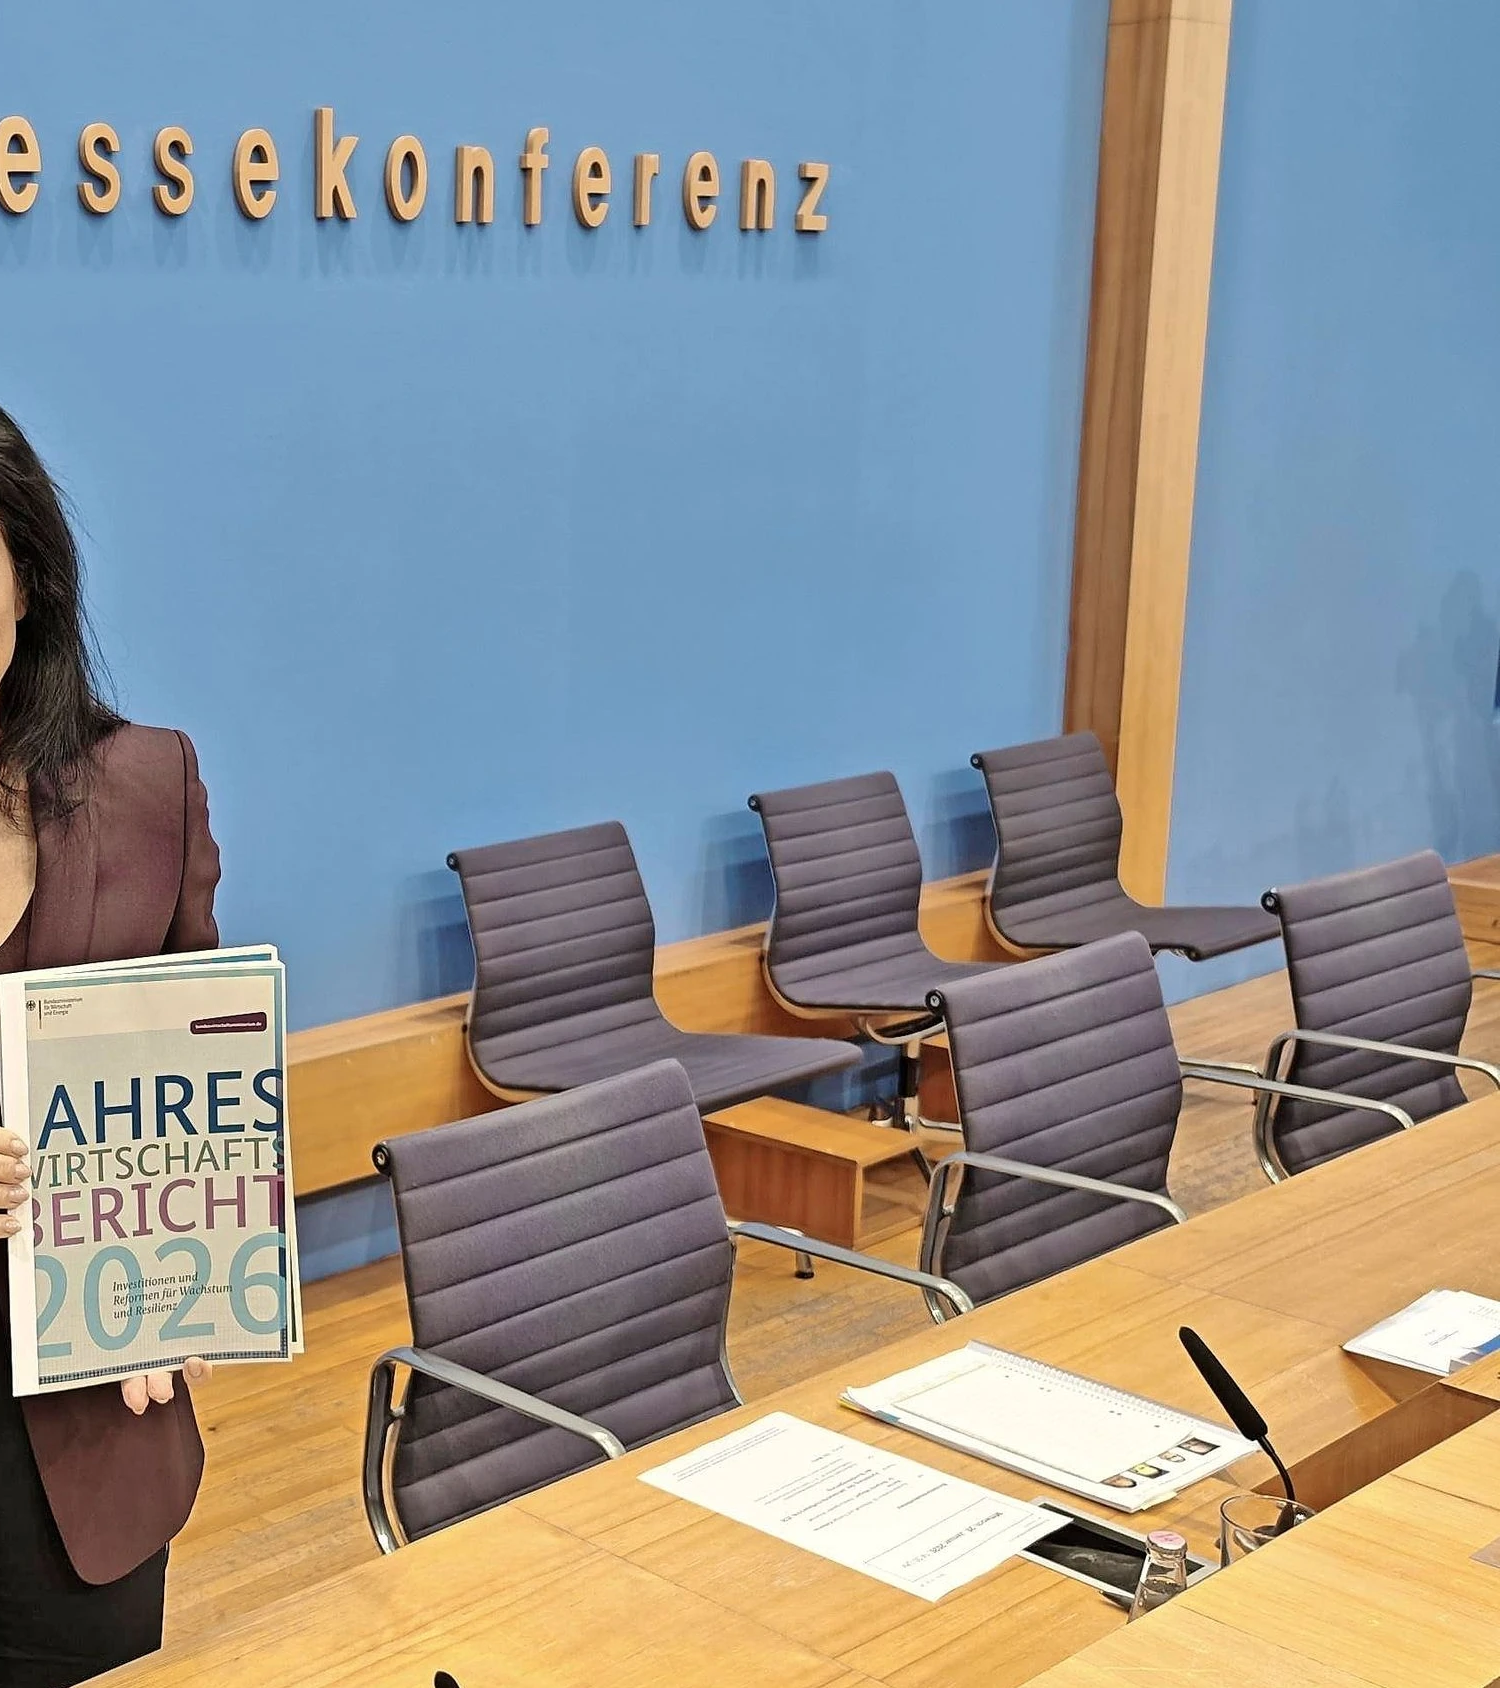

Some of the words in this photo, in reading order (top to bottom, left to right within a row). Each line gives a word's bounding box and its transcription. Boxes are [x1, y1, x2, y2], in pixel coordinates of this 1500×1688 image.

[36, 1068, 284, 1150] AHRES
[112, 1275, 176, 1292] Investitionen
[178, 1271, 198, 1283] und
[34, 1232, 287, 1359] 2026
[113, 1290, 160, 1306] Reformen
[160, 1287, 178, 1302] für
[179, 1283, 233, 1297] Wachstum
[113, 1307, 132, 1319] und
[134, 1301, 179, 1316] Resilienz
